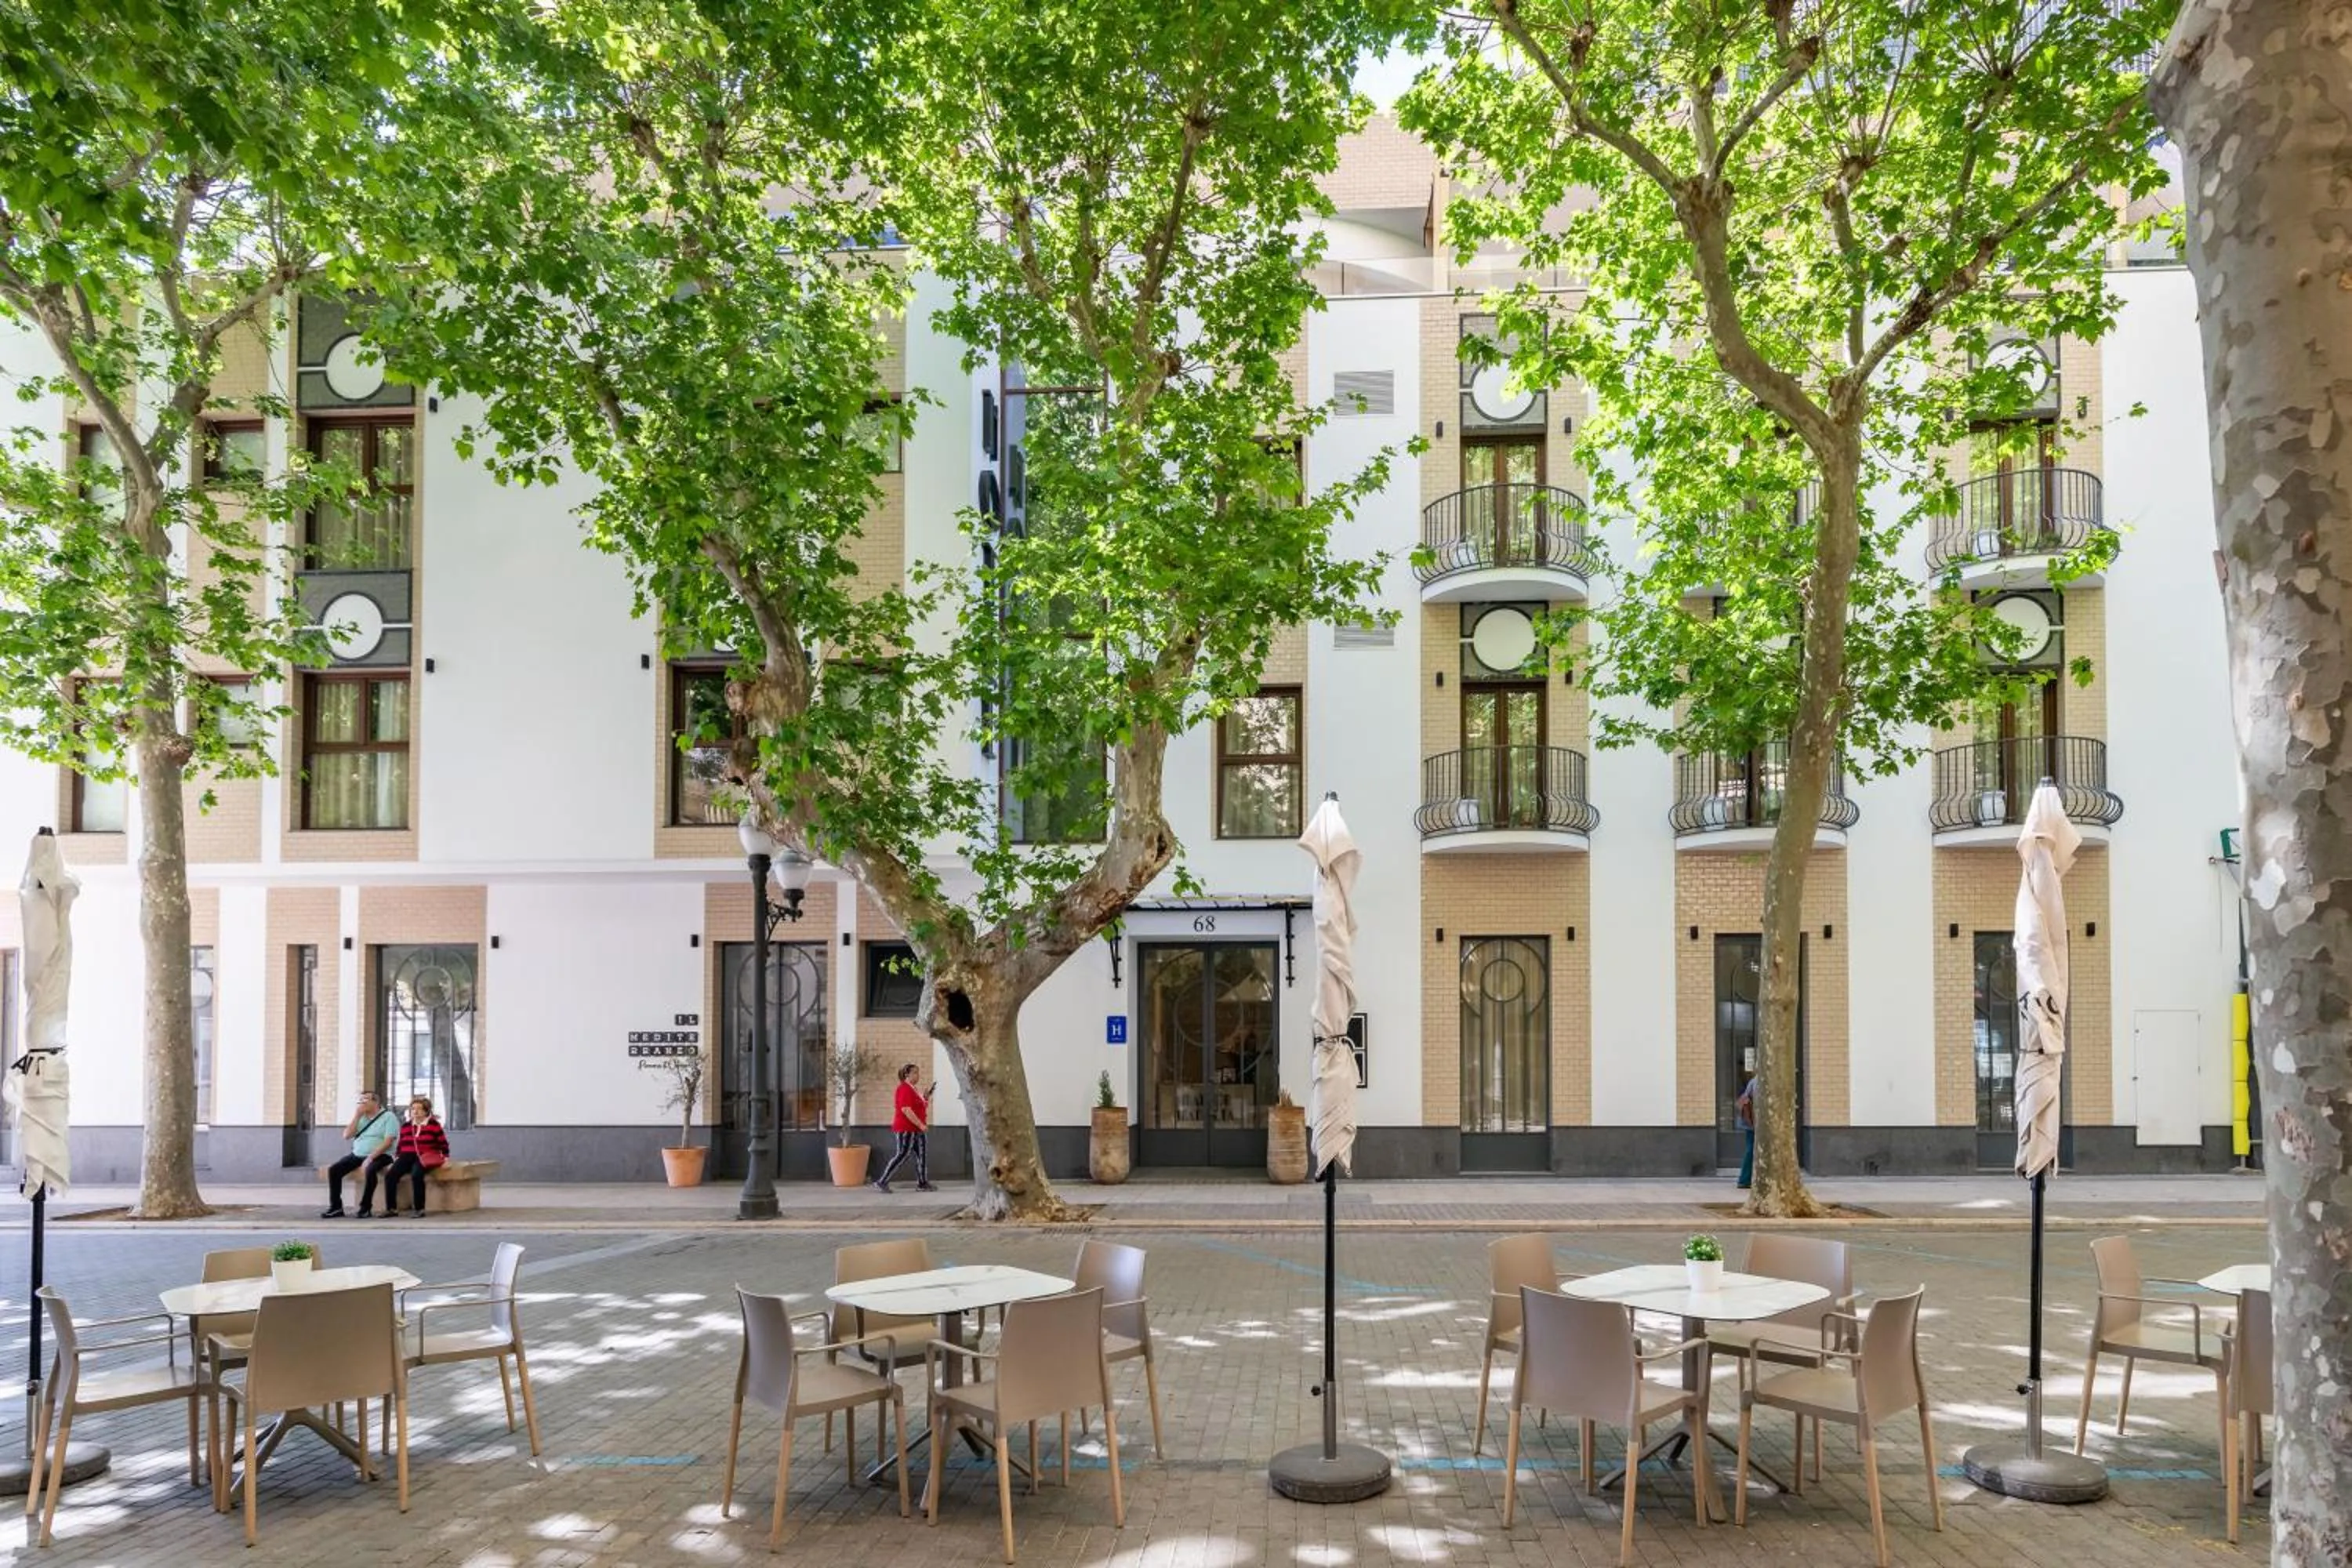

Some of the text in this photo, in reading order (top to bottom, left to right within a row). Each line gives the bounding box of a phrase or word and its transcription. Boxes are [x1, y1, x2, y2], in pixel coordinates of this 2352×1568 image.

[1193, 916, 1216, 932] 68
[677, 1015, 697, 1025] IL
[1112, 1024, 1122, 1036] H
[629, 1032, 697, 1042] MEDITE
